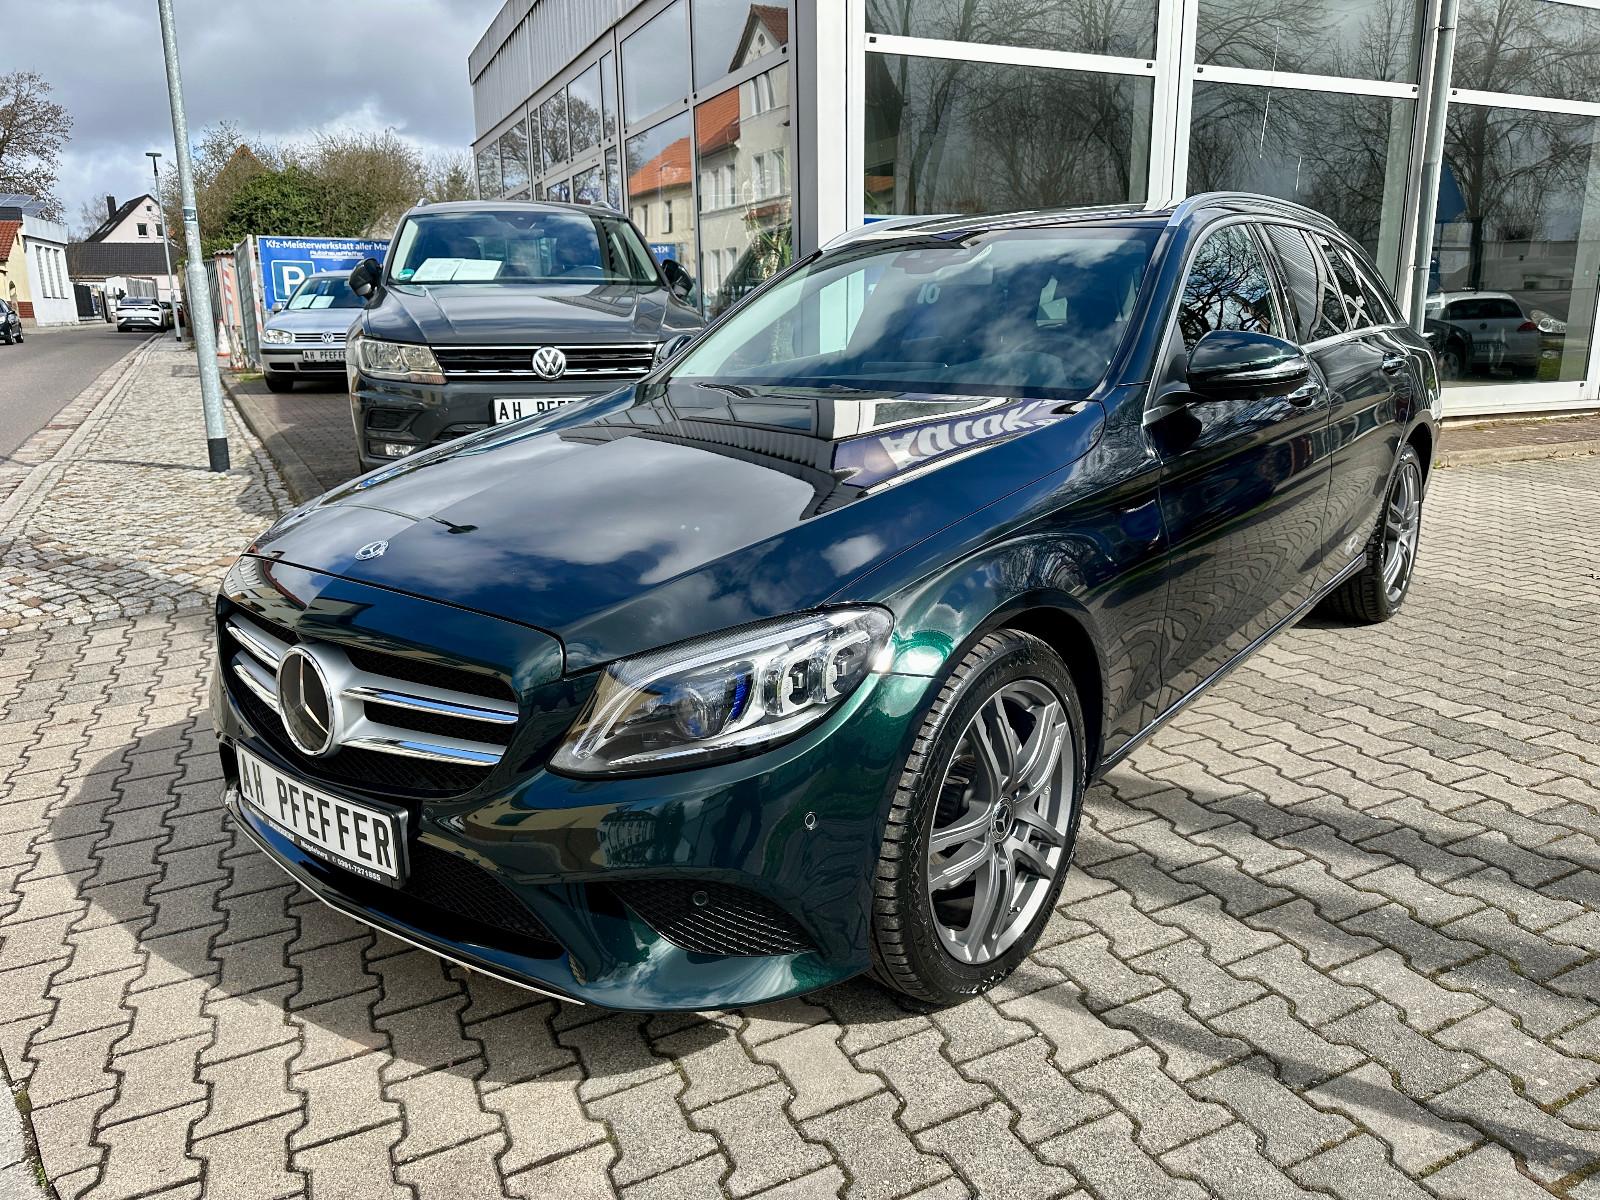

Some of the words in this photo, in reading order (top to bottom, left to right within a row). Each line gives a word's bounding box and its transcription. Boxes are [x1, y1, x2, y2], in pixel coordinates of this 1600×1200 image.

[265, 239, 354, 251] Kfz-Meisterwerkstatt
[355, 242, 372, 251] aller
[282, 266, 306, 296] P
[304, 351, 315, 360] AH
[500, 401, 522, 420] AH
[241, 753, 266, 807] AH
[275, 776, 393, 870] PFEFFER
